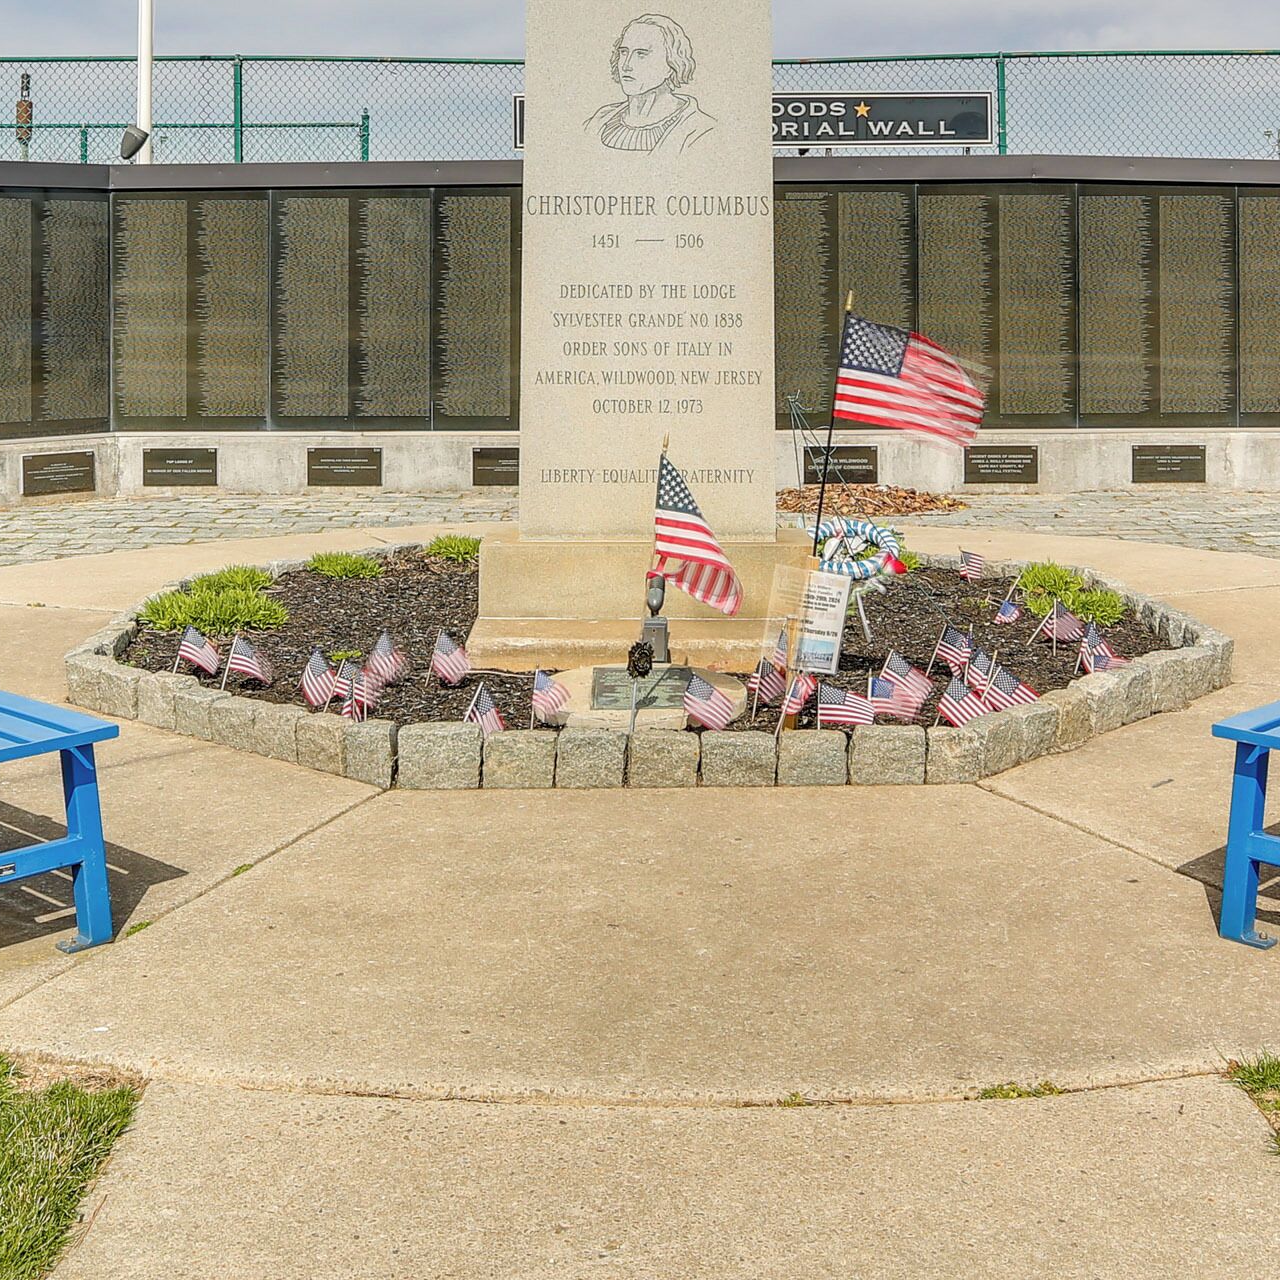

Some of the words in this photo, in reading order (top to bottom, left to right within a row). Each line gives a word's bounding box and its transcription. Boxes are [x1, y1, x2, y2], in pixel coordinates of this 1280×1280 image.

[867, 121, 956, 136] WALL
[526, 195, 656, 216] CHRISTOPHER
[666, 195, 770, 216] COLUMBUS
[592, 234, 620, 248] 1451
[675, 234, 704, 248] 1506
[560, 284, 633, 299] DEDICATED
[639, 284, 656, 299] BY
[661, 284, 687, 299] THE
[693, 284, 737, 299] LODGE
[714, 313, 743, 328] 1838
[563, 341, 607, 356] ORDER
[613, 341, 648, 356] SONS
[654, 341, 670, 356] OF
[676, 341, 712, 356] ITALY
[718, 341, 733, 356] IN
[534, 370, 600, 386] AMERICA,
[601, 370, 677, 386] WILDWOOD,
[681, 370, 710, 386] NEW
[714, 370, 763, 386] JERSEY
[592, 399, 653, 415] OCTOBER
[658, 399, 673, 415] 12,
[677, 399, 704, 415] 1973
[680, 469, 755, 483] RATERNITY
